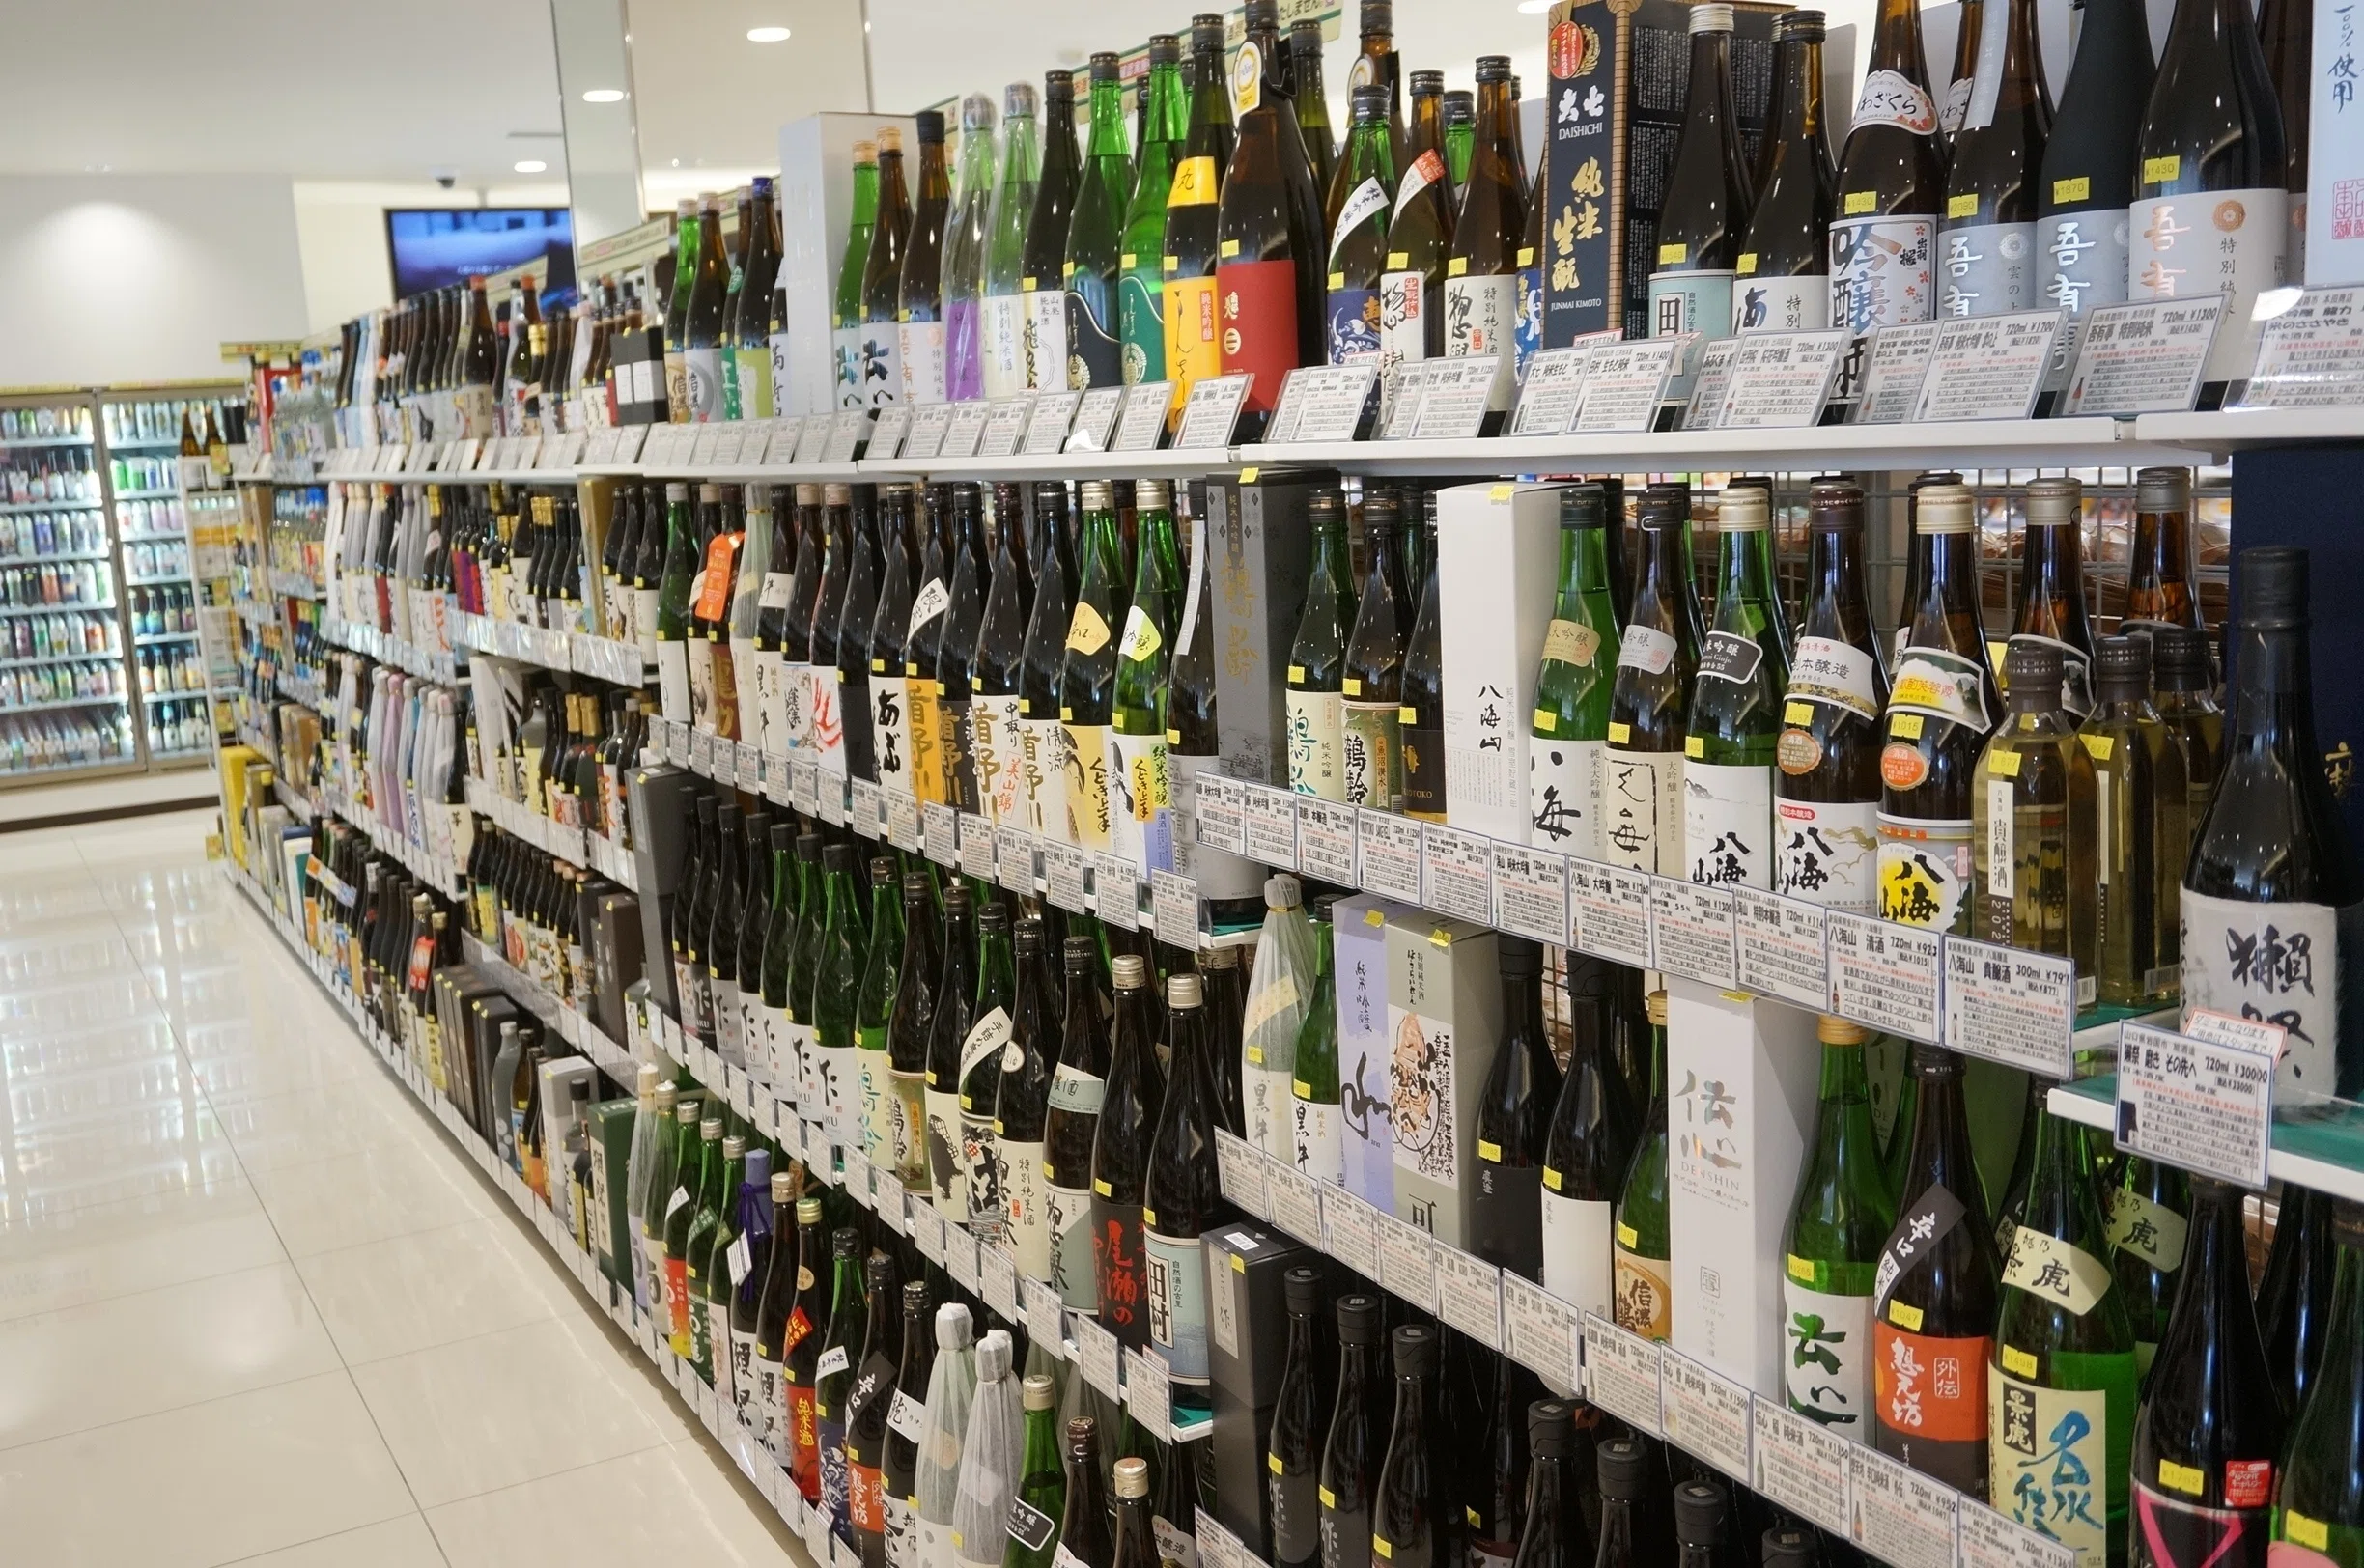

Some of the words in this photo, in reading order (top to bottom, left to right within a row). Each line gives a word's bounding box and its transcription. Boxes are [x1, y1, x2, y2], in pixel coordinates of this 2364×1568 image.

[1559, 122, 1603, 140] DAISHICHI
[2145, 163, 2175, 178] ¥1430
[1846, 196, 1873, 207] ¥1430
[1551, 300, 1575, 311] JUNMAI
[1576, 297, 1602, 309] KIMOTO
[1786, 294, 1802, 329] 特別
[2161, 310, 2187, 324] 720ml
[2190, 307, 2217, 322] ¥1300
[1482, 287, 1500, 355] 特別純米酒
[2004, 323, 2027, 335] 720ml
[2030, 320, 2056, 333] ¥1700
[2118, 320, 2154, 340] 特別純米
[2267, 318, 2350, 331] 米のささやき
[1795, 342, 1815, 353] 720ml
[1817, 340, 1839, 350] ¥1300
[2083, 342, 2117, 352] 日本酒度
[1478, 684, 1504, 753] 八海山
[1893, 720, 1920, 733] ¥1015
[1320, 742, 1332, 779] 純米吟醸
[998, 758, 1022, 813] 美山錦
[1152, 745, 1170, 807] 純米吟醸
[1590, 748, 1601, 800] 純米大吟醸
[1666, 761, 1678, 793] 大吟醸
[1088, 756, 1111, 834] くどき上手
[1133, 758, 1148, 819] くどき上手
[1311, 810, 1328, 826] 本醸造
[1533, 859, 1546, 871] 720ml
[1570, 872, 1590, 888] 八海山
[1592, 877, 1612, 895] 大吟醸
[1615, 877, 1630, 889] 720ml
[1632, 882, 1649, 895] ¥1760
[1659, 890, 1677, 901] 八海山
[1694, 894, 1711, 908] 720ml
[1713, 900, 1733, 914] ¥1300
[1753, 904, 1781, 928] 特別本醸造
[1786, 909, 1804, 922] 720ml
[1828, 945, 1858, 958] 日本酒度
[1829, 926, 1857, 947] 八海山
[1866, 934, 1885, 954] 清酒
[1890, 936, 1912, 951] 720ml
[1916, 940, 1937, 957] ¥923
[1948, 953, 1975, 975] 八海山
[1984, 961, 2011, 984] 貴醸酒
[2015, 964, 2041, 979] 300ml
[1947, 974, 1978, 988] 日本酒度
[2124, 1030, 2168, 1048] 山口県岩国市
[2173, 1041, 2197, 1057] 旭酒造
[2122, 1066, 2165, 1083] 日本酒度
[2144, 1048, 2160, 1070] 磨き
[2165, 1053, 2197, 1078] その先へ
[2205, 1055, 2230, 1075] 720ml
[2234, 1062, 2268, 1083] ¥30000
[1681, 1160, 1740, 1191] DENSHIN
[1018, 1158, 1036, 1228] 特別純米酒
[1105, 1219, 1138, 1328] 尾瀬の
[1147, 1257, 1170, 1343] 田村
[1629, 1344, 1645, 1359] 720ml
[1936, 1359, 1958, 1397] 外伝
[1710, 1381, 1728, 1398] 720ml
[1730, 1391, 1749, 1410] ¥1500
[1755, 1410, 1768, 1430] 伝心
[1783, 1423, 1804, 1447] 純米酒
[2005, 1388, 2034, 1453] 景虎
[1807, 1430, 1825, 1448] 720ml
[1828, 1441, 1849, 1461] ¥1150
[1910, 1481, 1932, 1500] 720ml
[1935, 1493, 1956, 1514] ¥952
[2021, 1537, 2044, 1557] 720ml
